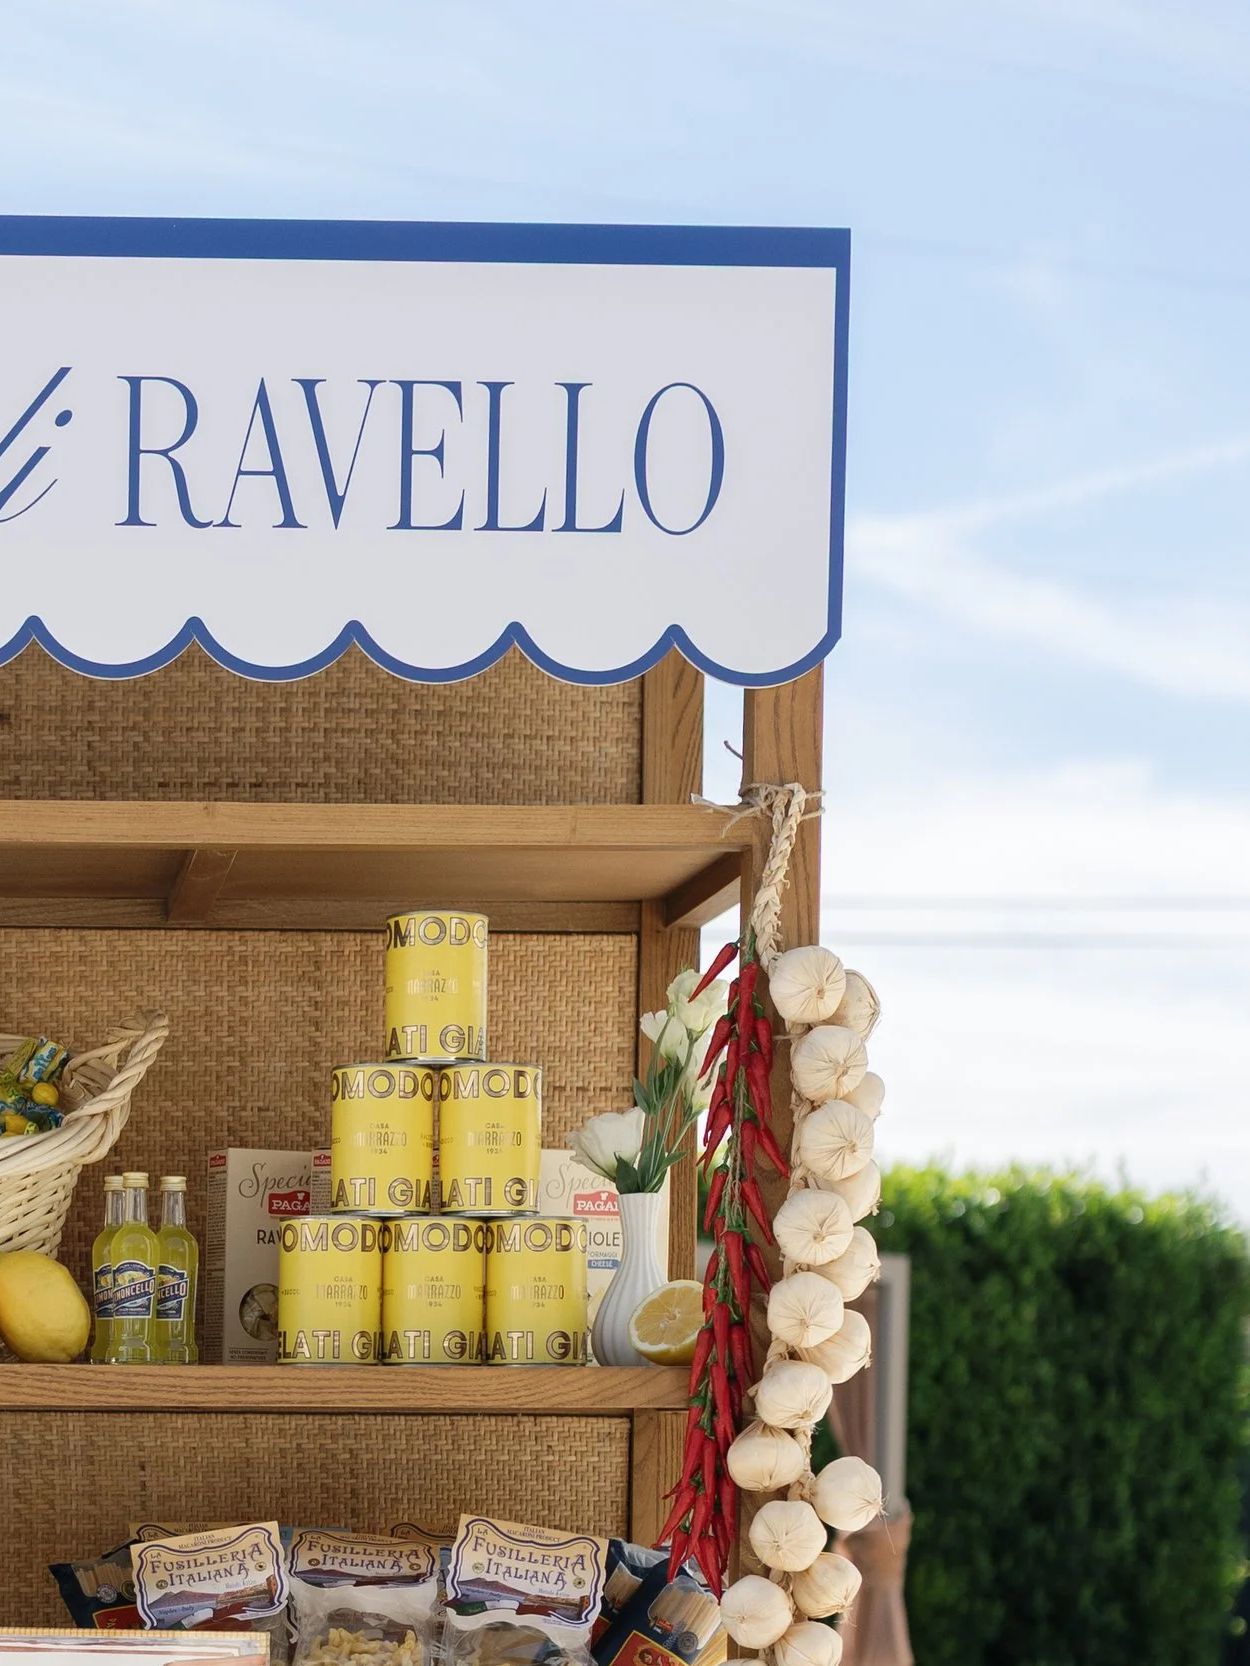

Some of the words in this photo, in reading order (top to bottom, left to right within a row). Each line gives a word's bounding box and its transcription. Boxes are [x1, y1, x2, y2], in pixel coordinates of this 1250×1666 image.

[114, 374, 725, 536] RAVELLO
[588, 1232, 622, 1246] IOLE
[150, 1542, 265, 1573] FUSILLERIA
[307, 1540, 421, 1560] FUSILLERIA
[321, 1554, 403, 1571] ITALIANA
[472, 1536, 586, 1572] FUSILLERIA
[169, 1562, 250, 1587] ITALIANA
[485, 1558, 567, 1588] ITALIANA
